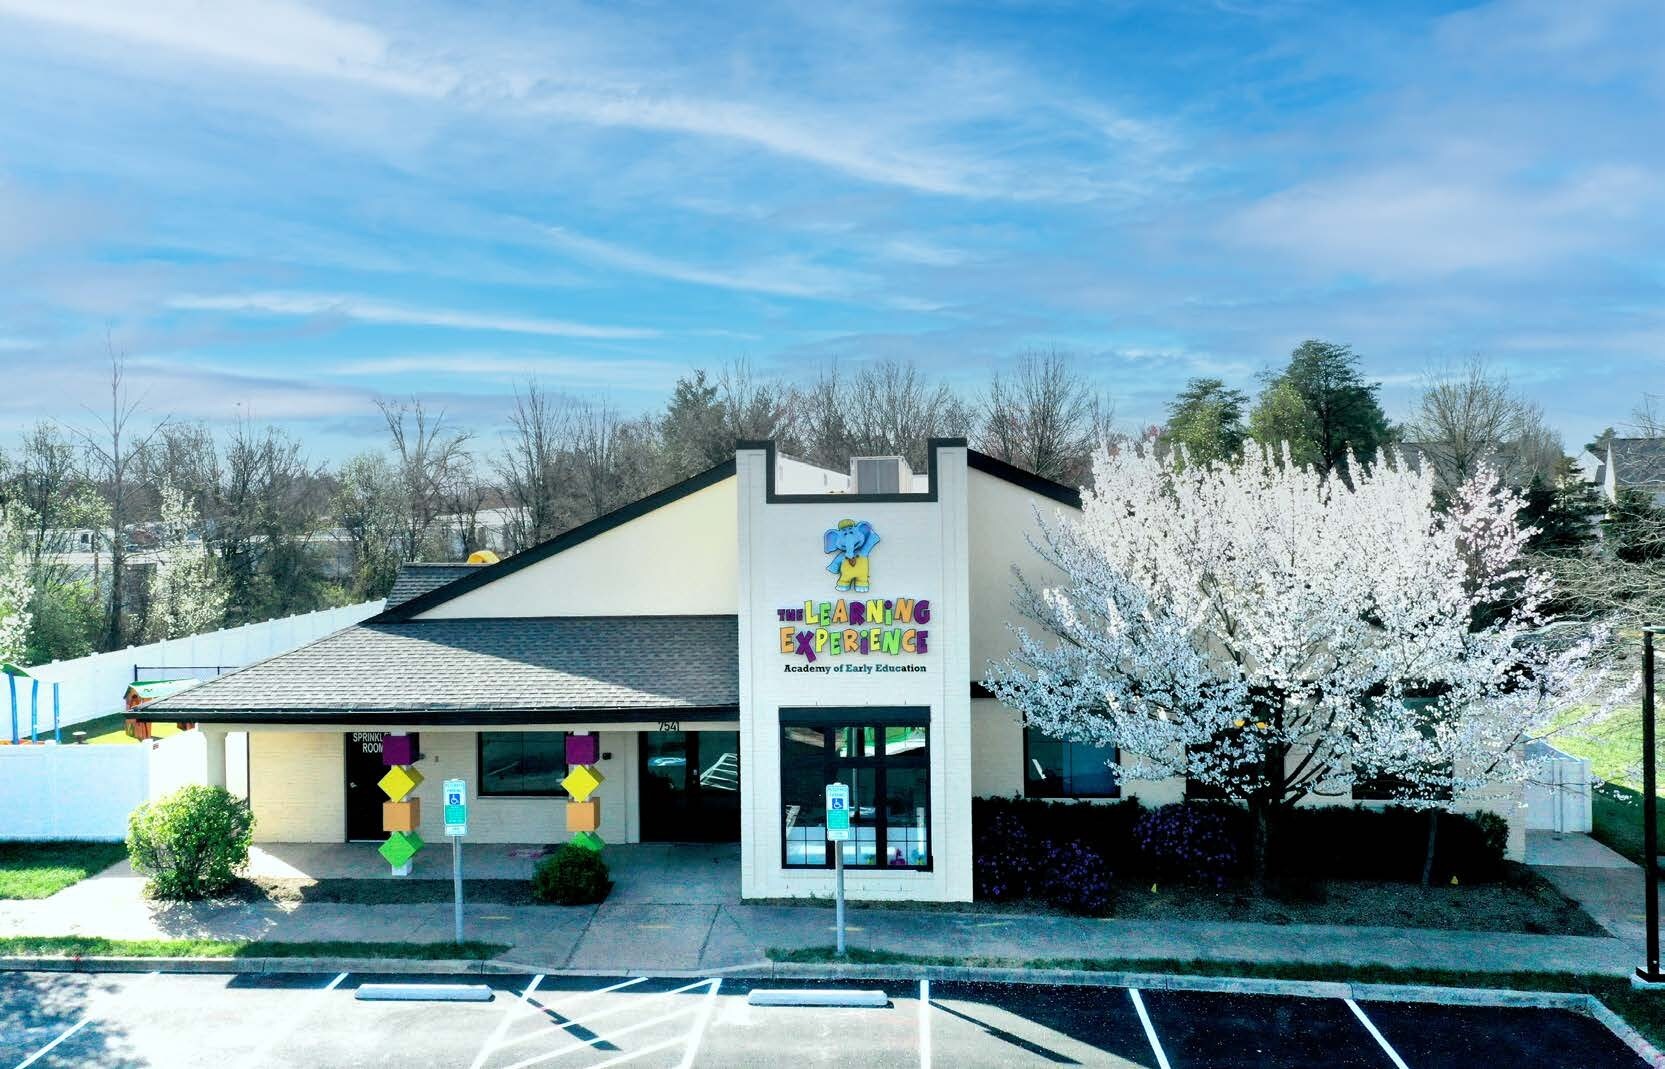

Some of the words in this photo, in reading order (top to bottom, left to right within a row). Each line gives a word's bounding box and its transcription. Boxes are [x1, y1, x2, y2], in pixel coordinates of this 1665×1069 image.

[777, 609, 803, 621] THE
[784, 664, 831, 674] Academy
[833, 664, 843, 673] of
[845, 664, 873, 674] Early
[875, 664, 927, 673] Education
[658, 720, 679, 731] 7541
